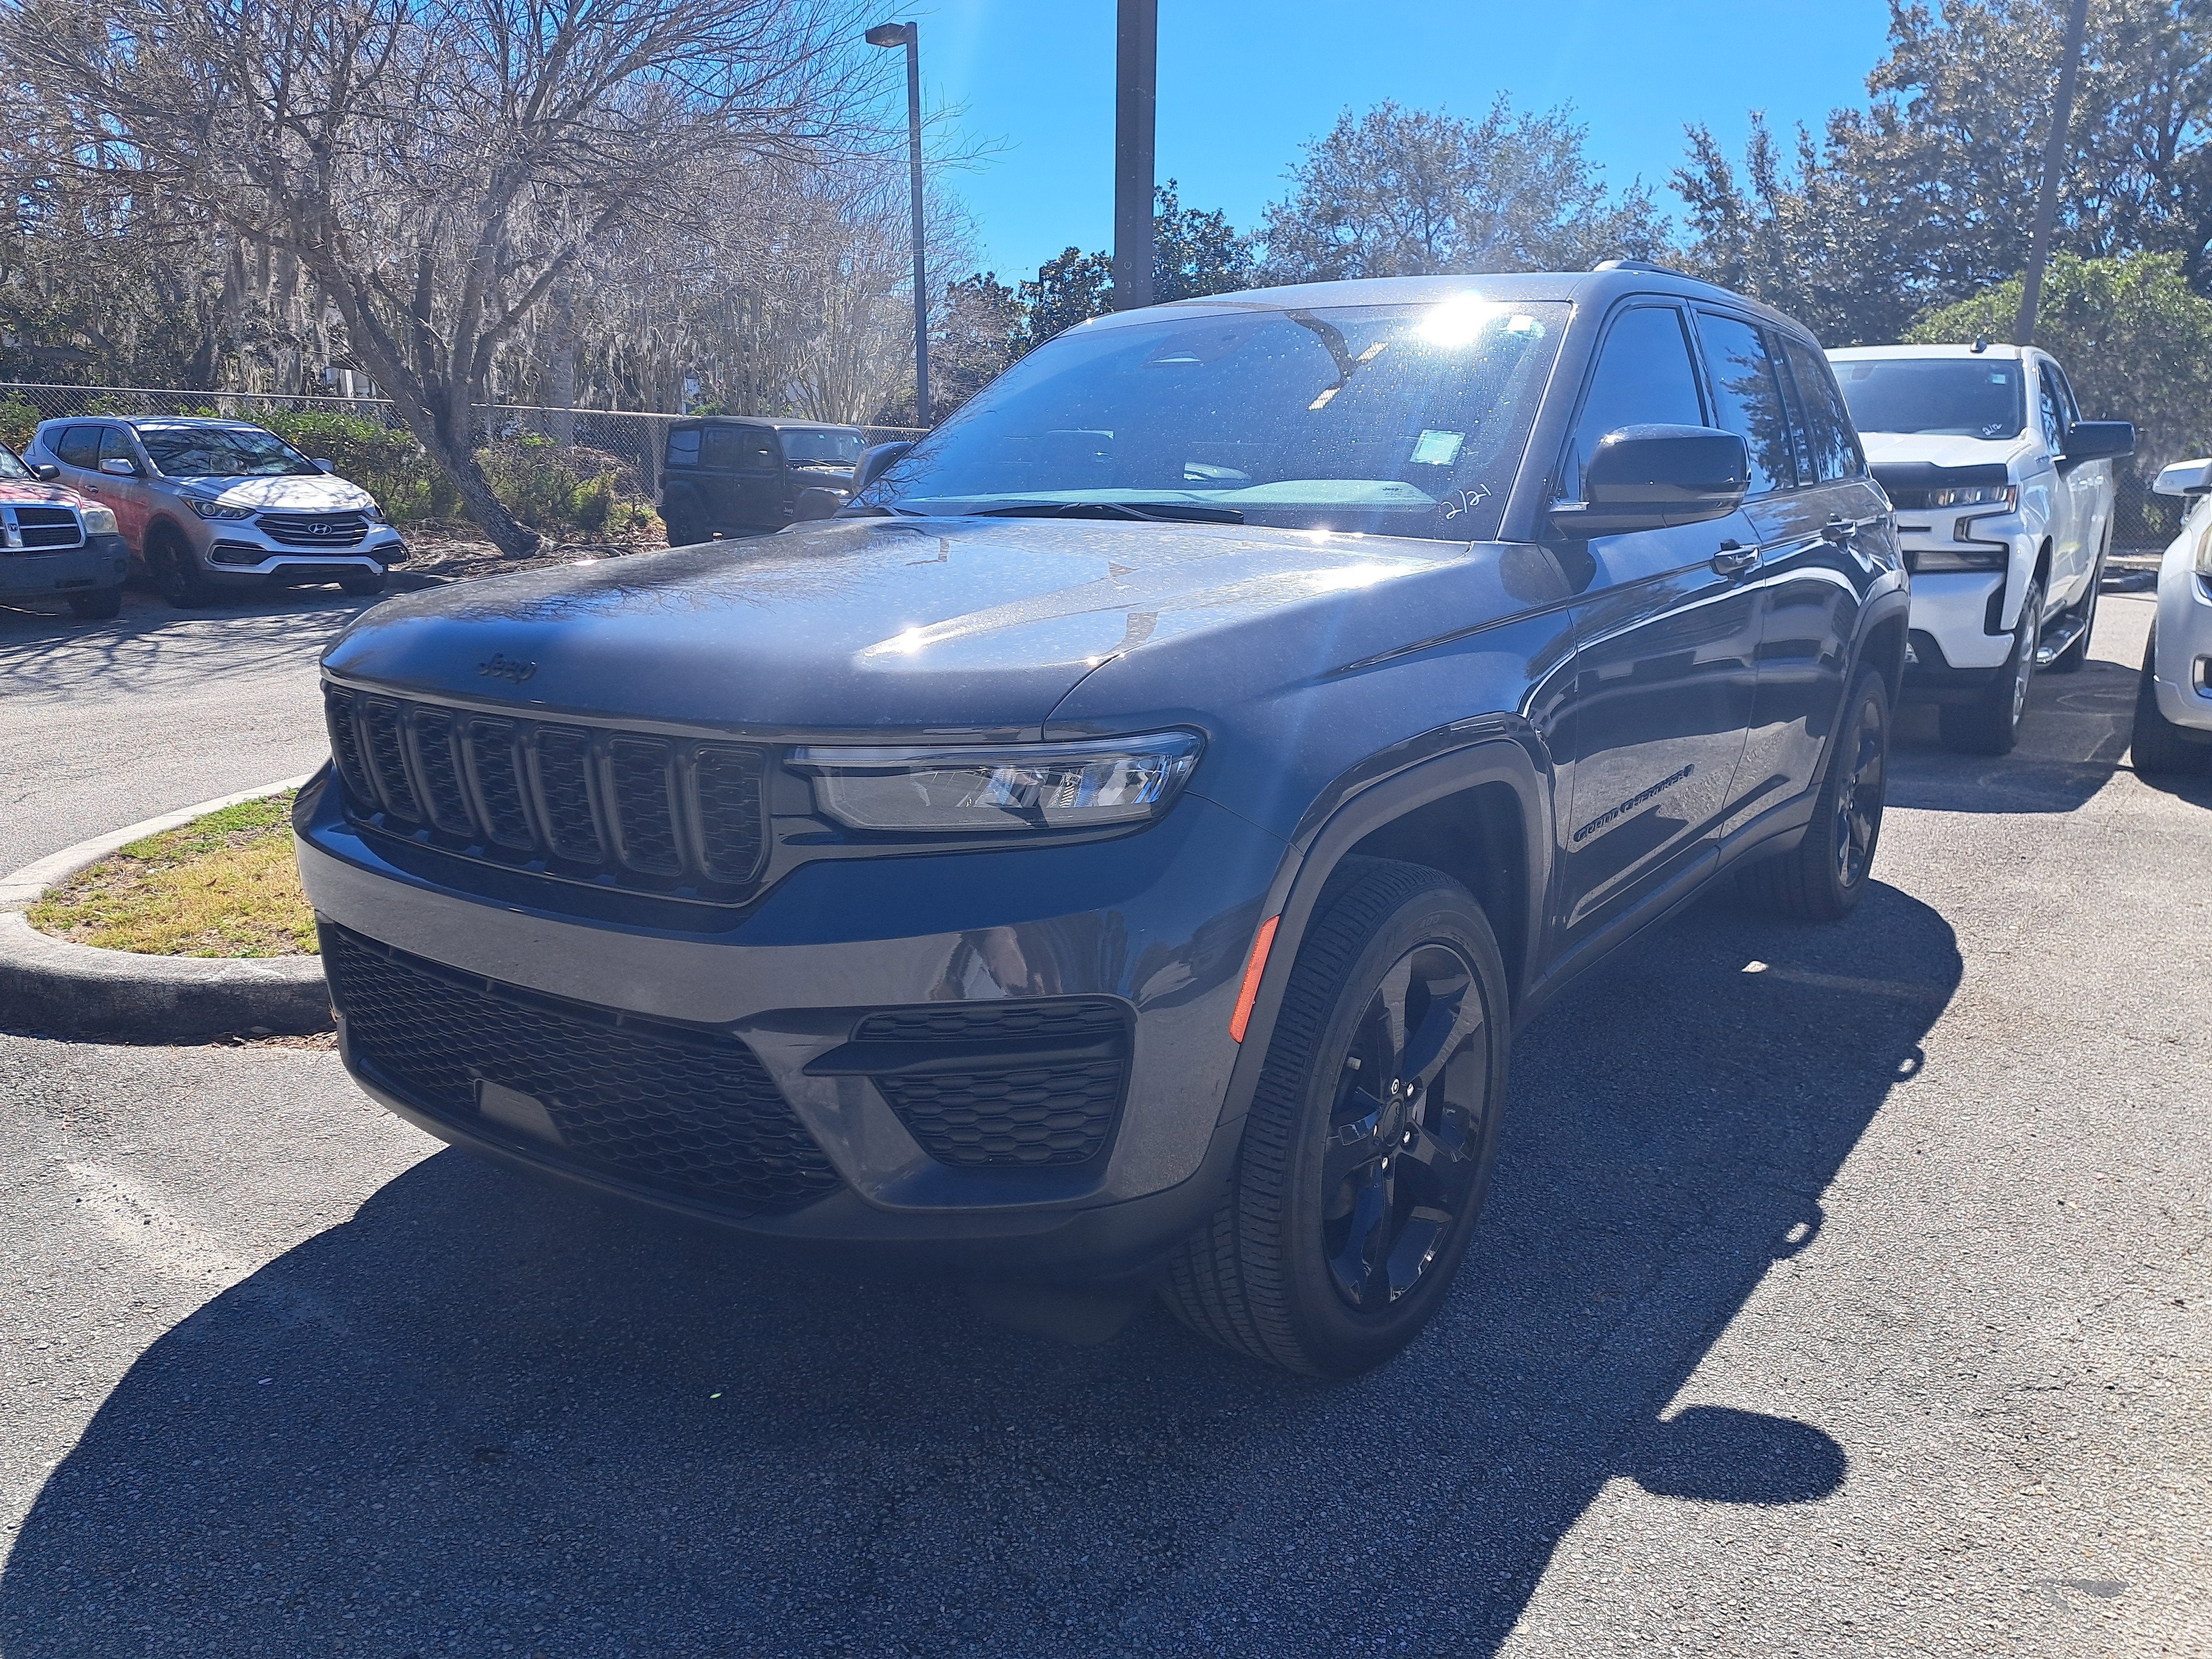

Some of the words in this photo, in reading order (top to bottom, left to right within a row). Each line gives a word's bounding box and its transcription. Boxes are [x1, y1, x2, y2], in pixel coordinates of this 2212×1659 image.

[1440, 484, 1492, 520] 2/21
[477, 653, 537, 685] Jeep
[1573, 807, 1619, 842] GRAND
